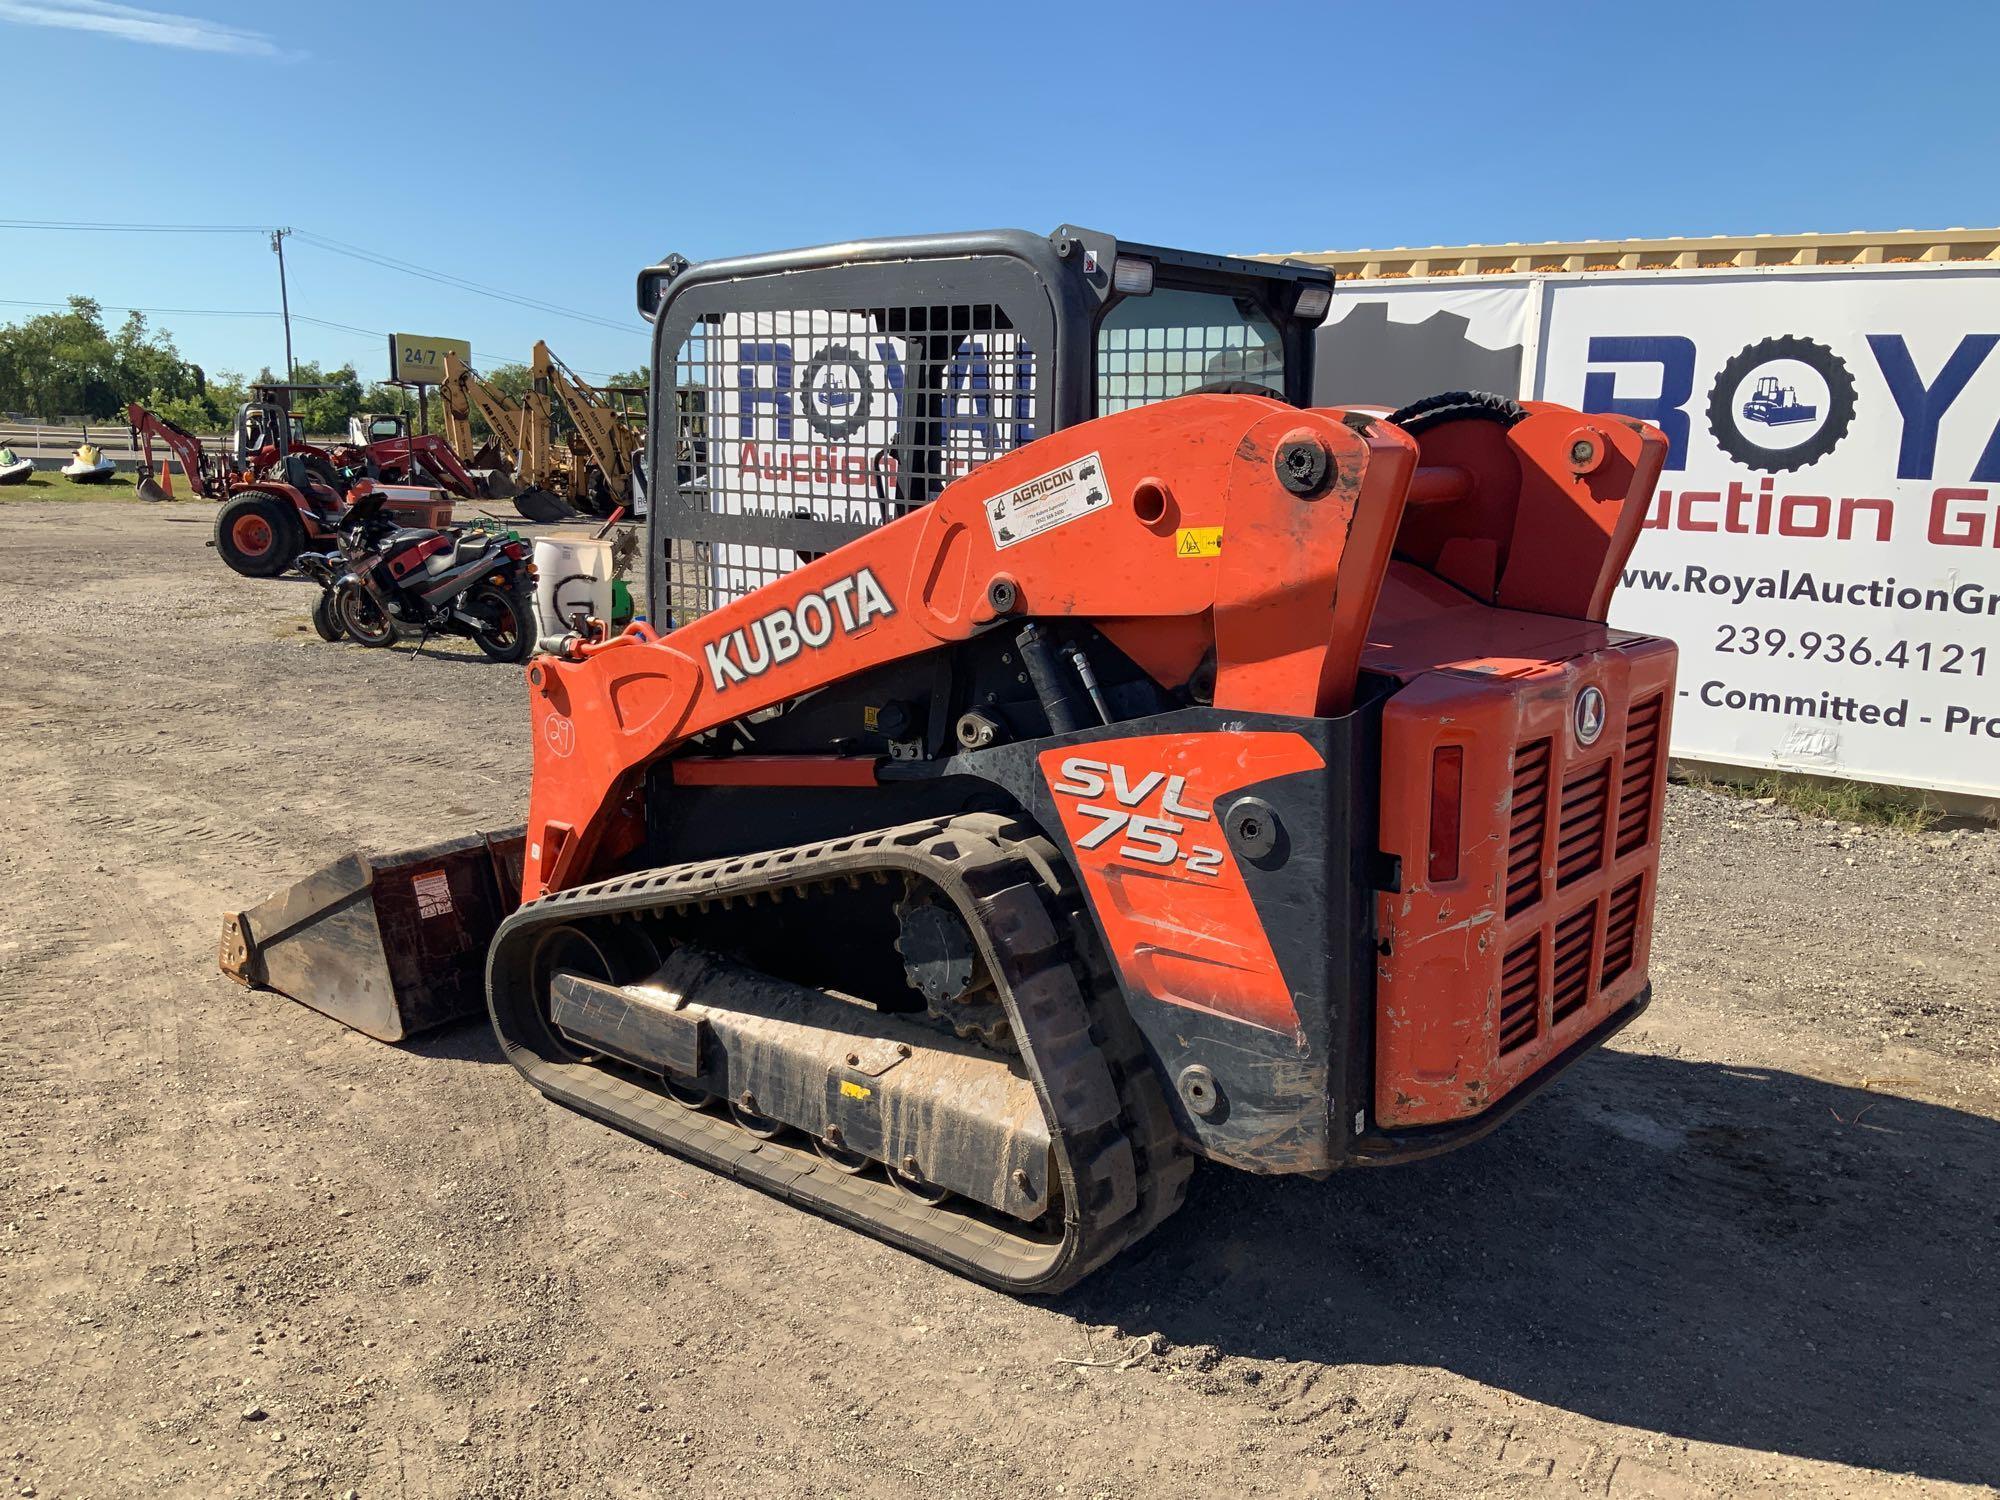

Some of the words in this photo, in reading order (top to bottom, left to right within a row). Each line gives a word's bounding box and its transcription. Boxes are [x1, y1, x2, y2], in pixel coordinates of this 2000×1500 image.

[405, 348, 436, 365] 24/7
[491, 416, 514, 448] FORD
[576, 411, 599, 446] FORD
[1583, 333, 2000, 483] ROY
[1012, 469, 1075, 506] AGRICON
[1642, 478, 1895, 542] uction
[704, 567, 894, 691] KUBOTA
[1715, 624, 1987, 676] 239.936.4121
[1700, 680, 1908, 728] Committed
[550, 717, 569, 750] 29
[1053, 757, 1211, 821] SVL
[1075, 803, 1224, 876] 75-2
